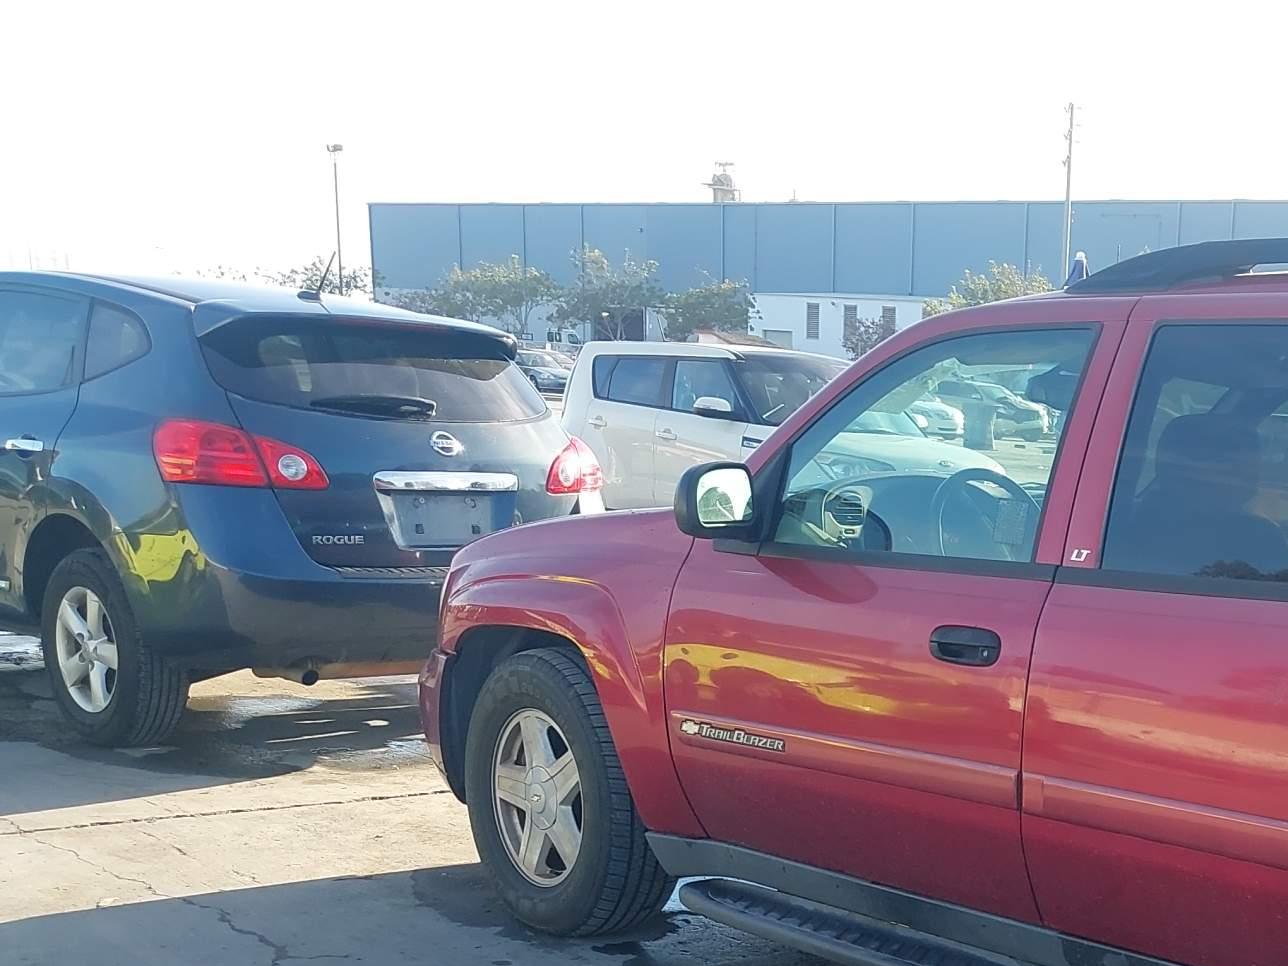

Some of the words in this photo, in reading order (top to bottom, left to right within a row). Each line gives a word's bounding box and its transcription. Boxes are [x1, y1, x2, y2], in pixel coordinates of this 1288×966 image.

[312, 535, 365, 545] ROGUE
[1070, 549, 1092, 562] LT
[701, 724, 785, 751] TRAILBLAZER
